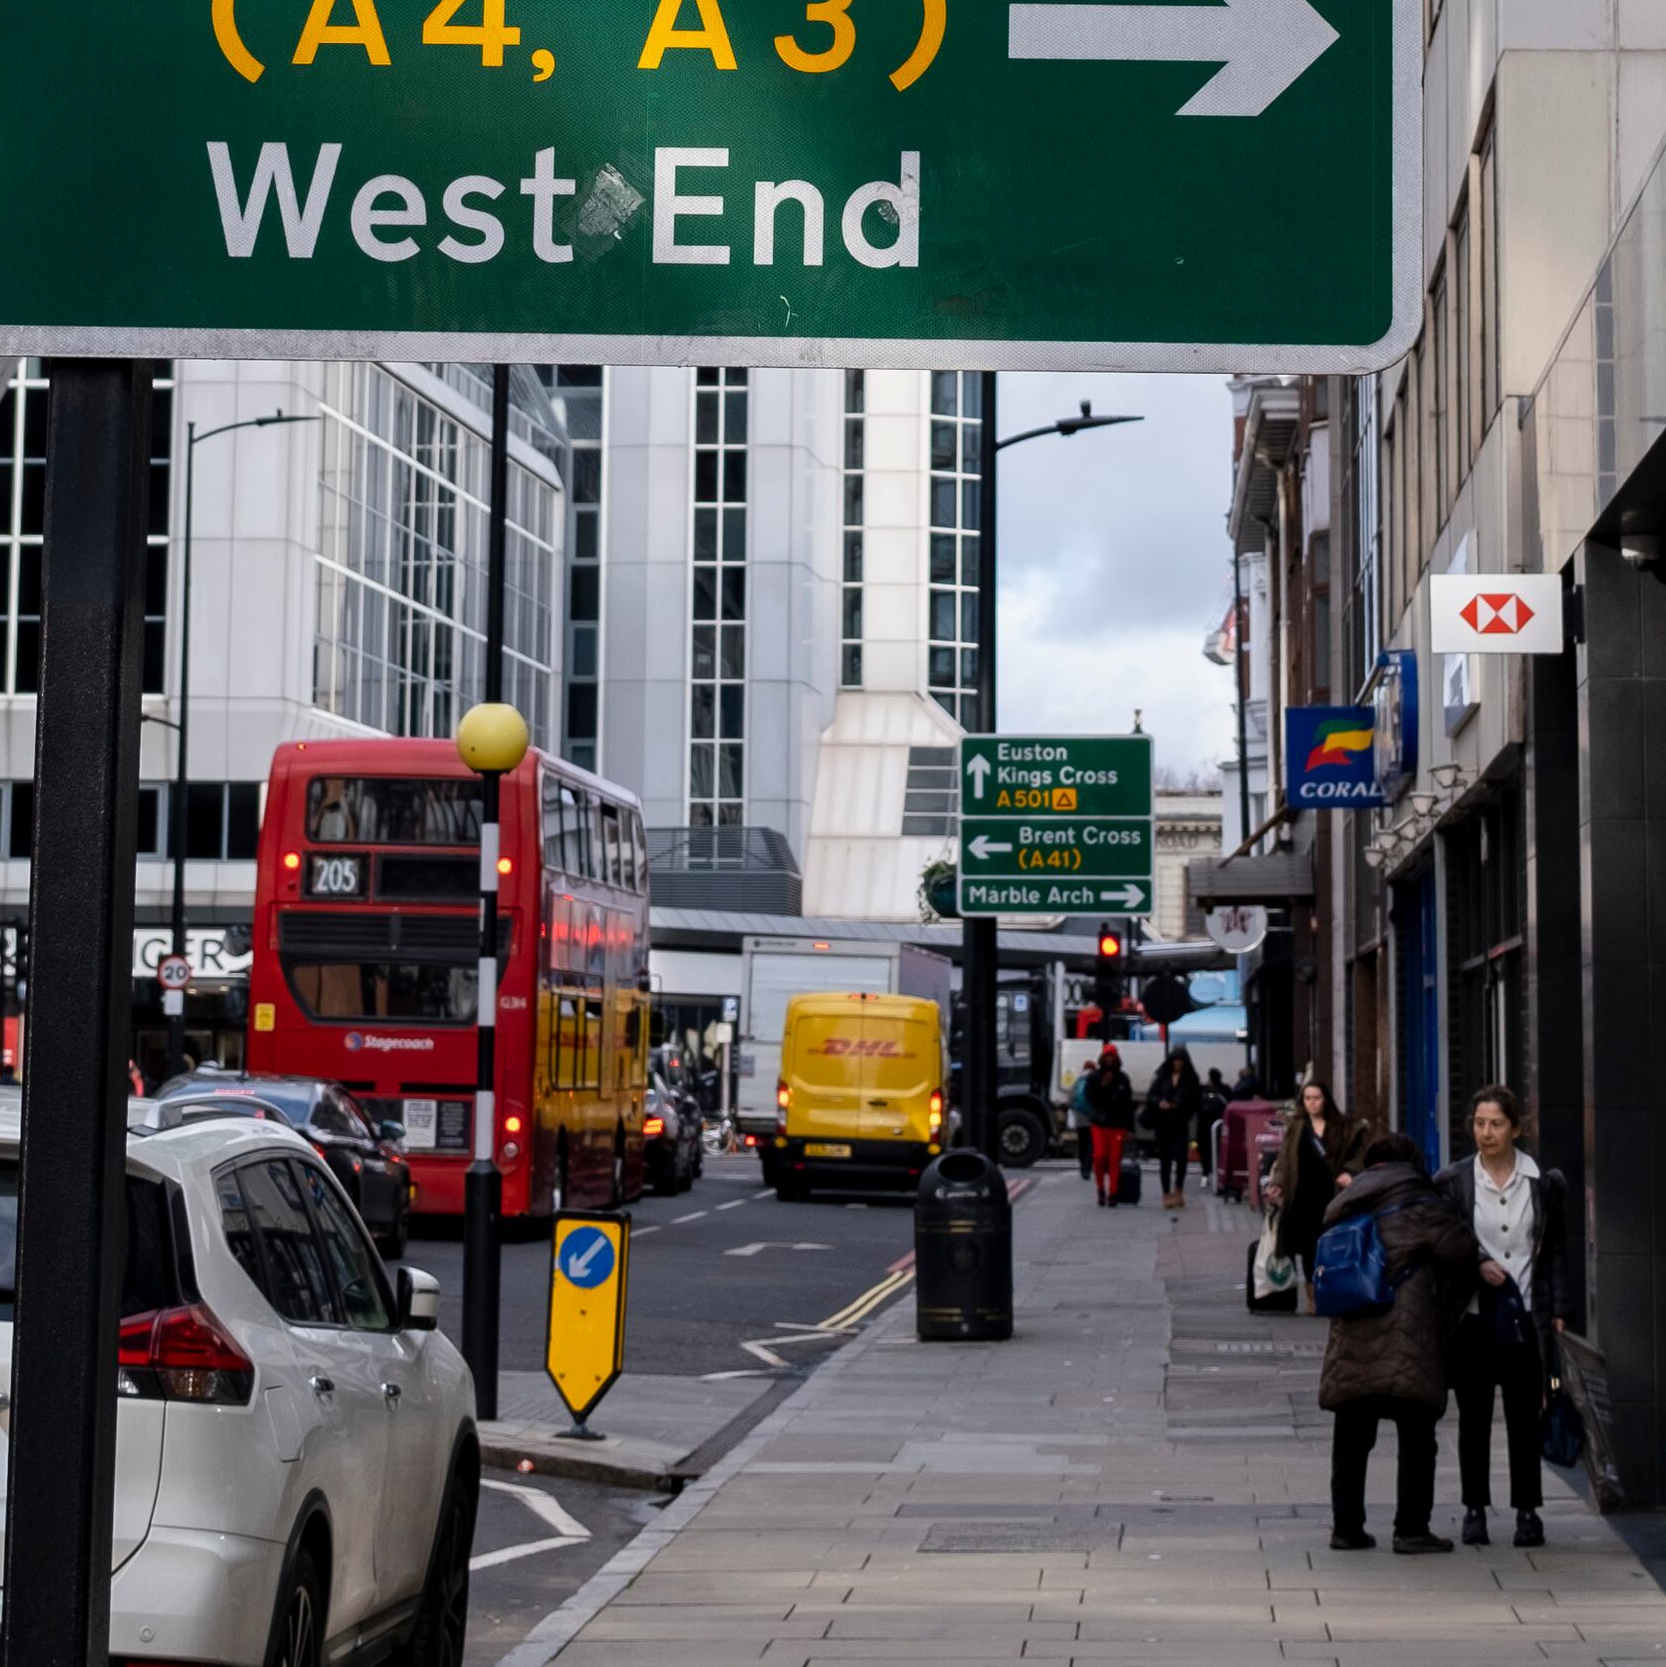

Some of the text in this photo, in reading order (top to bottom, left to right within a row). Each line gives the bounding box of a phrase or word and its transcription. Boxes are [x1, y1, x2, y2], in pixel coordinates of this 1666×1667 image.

[206, 141, 922, 268] West End
[997, 743, 1067, 761] Euston
[997, 766, 1118, 787] Kings Cross
[1299, 781, 1386, 799] CORAL
[1019, 827, 1141, 845] Brent Cross
[316, 859, 357, 892] 205
[968, 886, 1095, 904] Marble Arch
[164, 965, 187, 981] 20
[364, 1034, 435, 1052] Stagecoach
[825, 1038, 903, 1058] DHL
